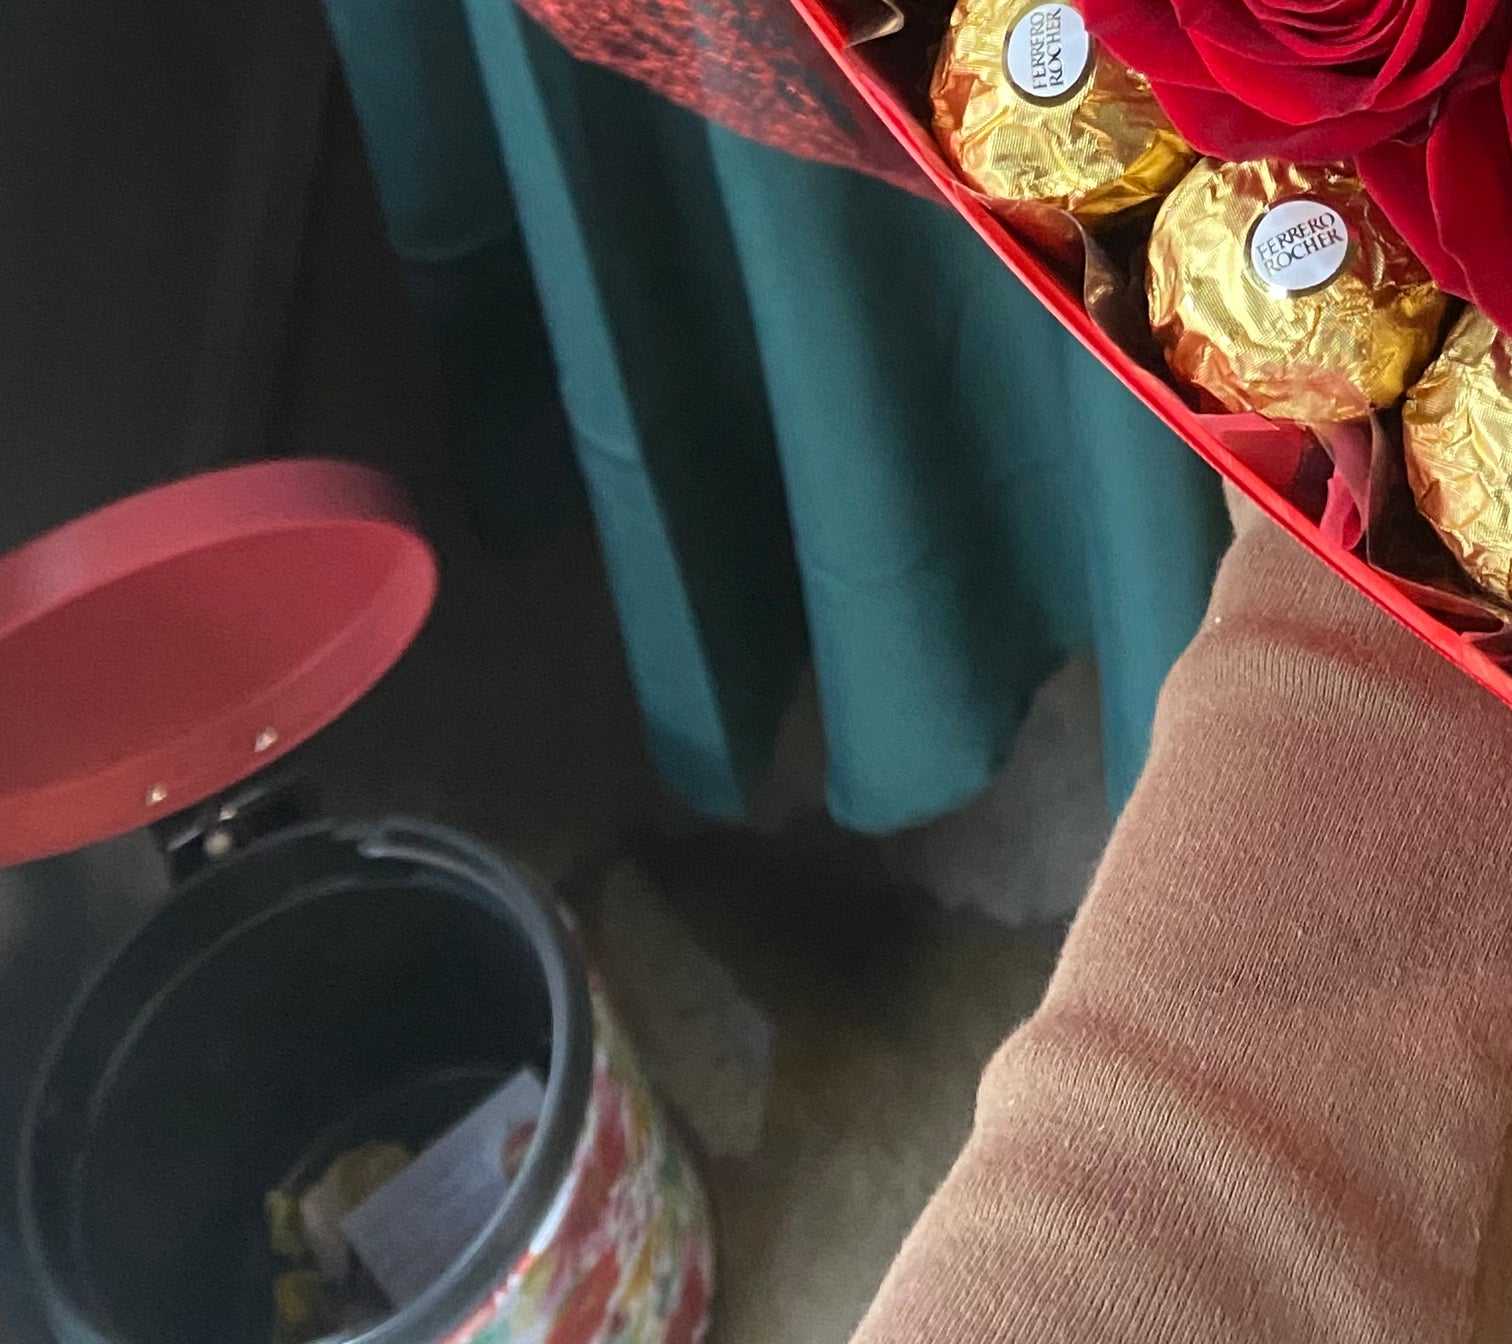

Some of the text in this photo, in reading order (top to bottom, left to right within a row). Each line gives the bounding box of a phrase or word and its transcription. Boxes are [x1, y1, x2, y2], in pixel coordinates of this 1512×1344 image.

[1030, 12, 1047, 89] FERRERO
[1046, 7, 1064, 86] ROCHER
[1256, 212, 1335, 260] FERRERO
[1264, 227, 1344, 275] ROCHER
